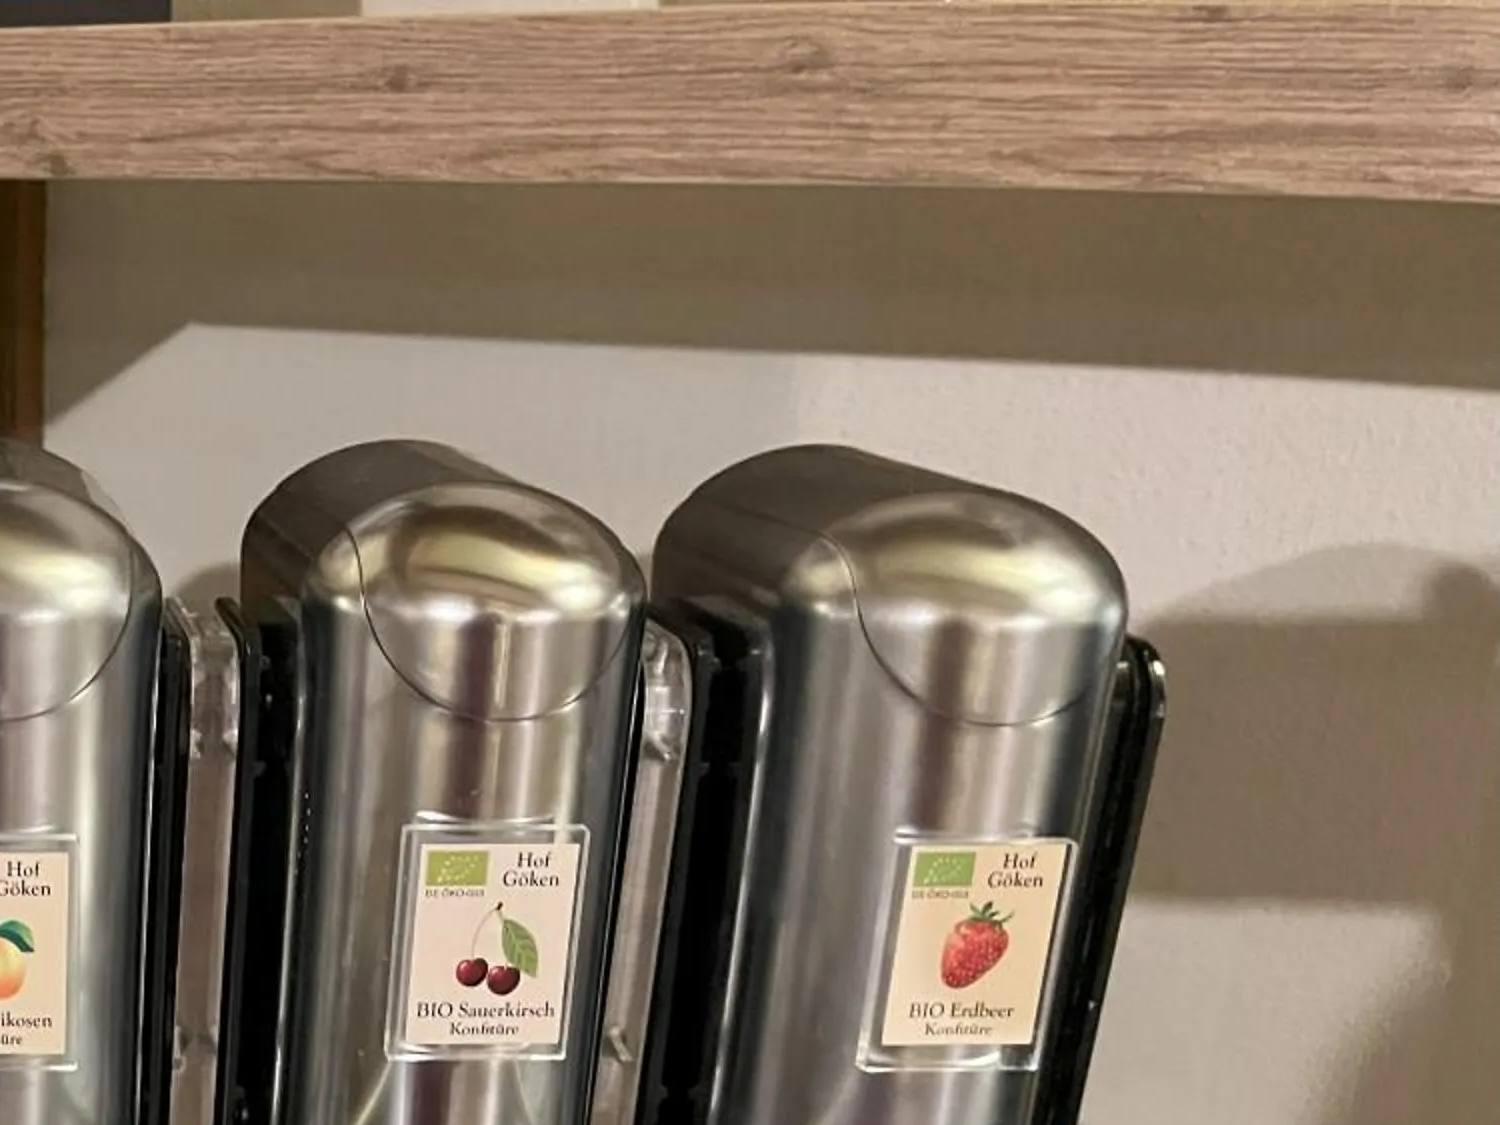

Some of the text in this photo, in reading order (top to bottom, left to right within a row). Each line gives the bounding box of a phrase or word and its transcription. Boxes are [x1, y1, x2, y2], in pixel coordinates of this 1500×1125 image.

[517, 851, 552, 868] Hof
[1003, 852, 1037, 869] Hof
[7, 861, 40, 878] Hof
[503, 870, 560, 887] Göken
[987, 871, 1044, 889] Göken
[417, 1001, 555, 1018] BIO Sauerkirsch
[909, 1002, 1015, 1019] BIO Erdbeer
[449, 1022, 519, 1036] Konfitüre
[925, 1022, 992, 1037] Konfitüre
